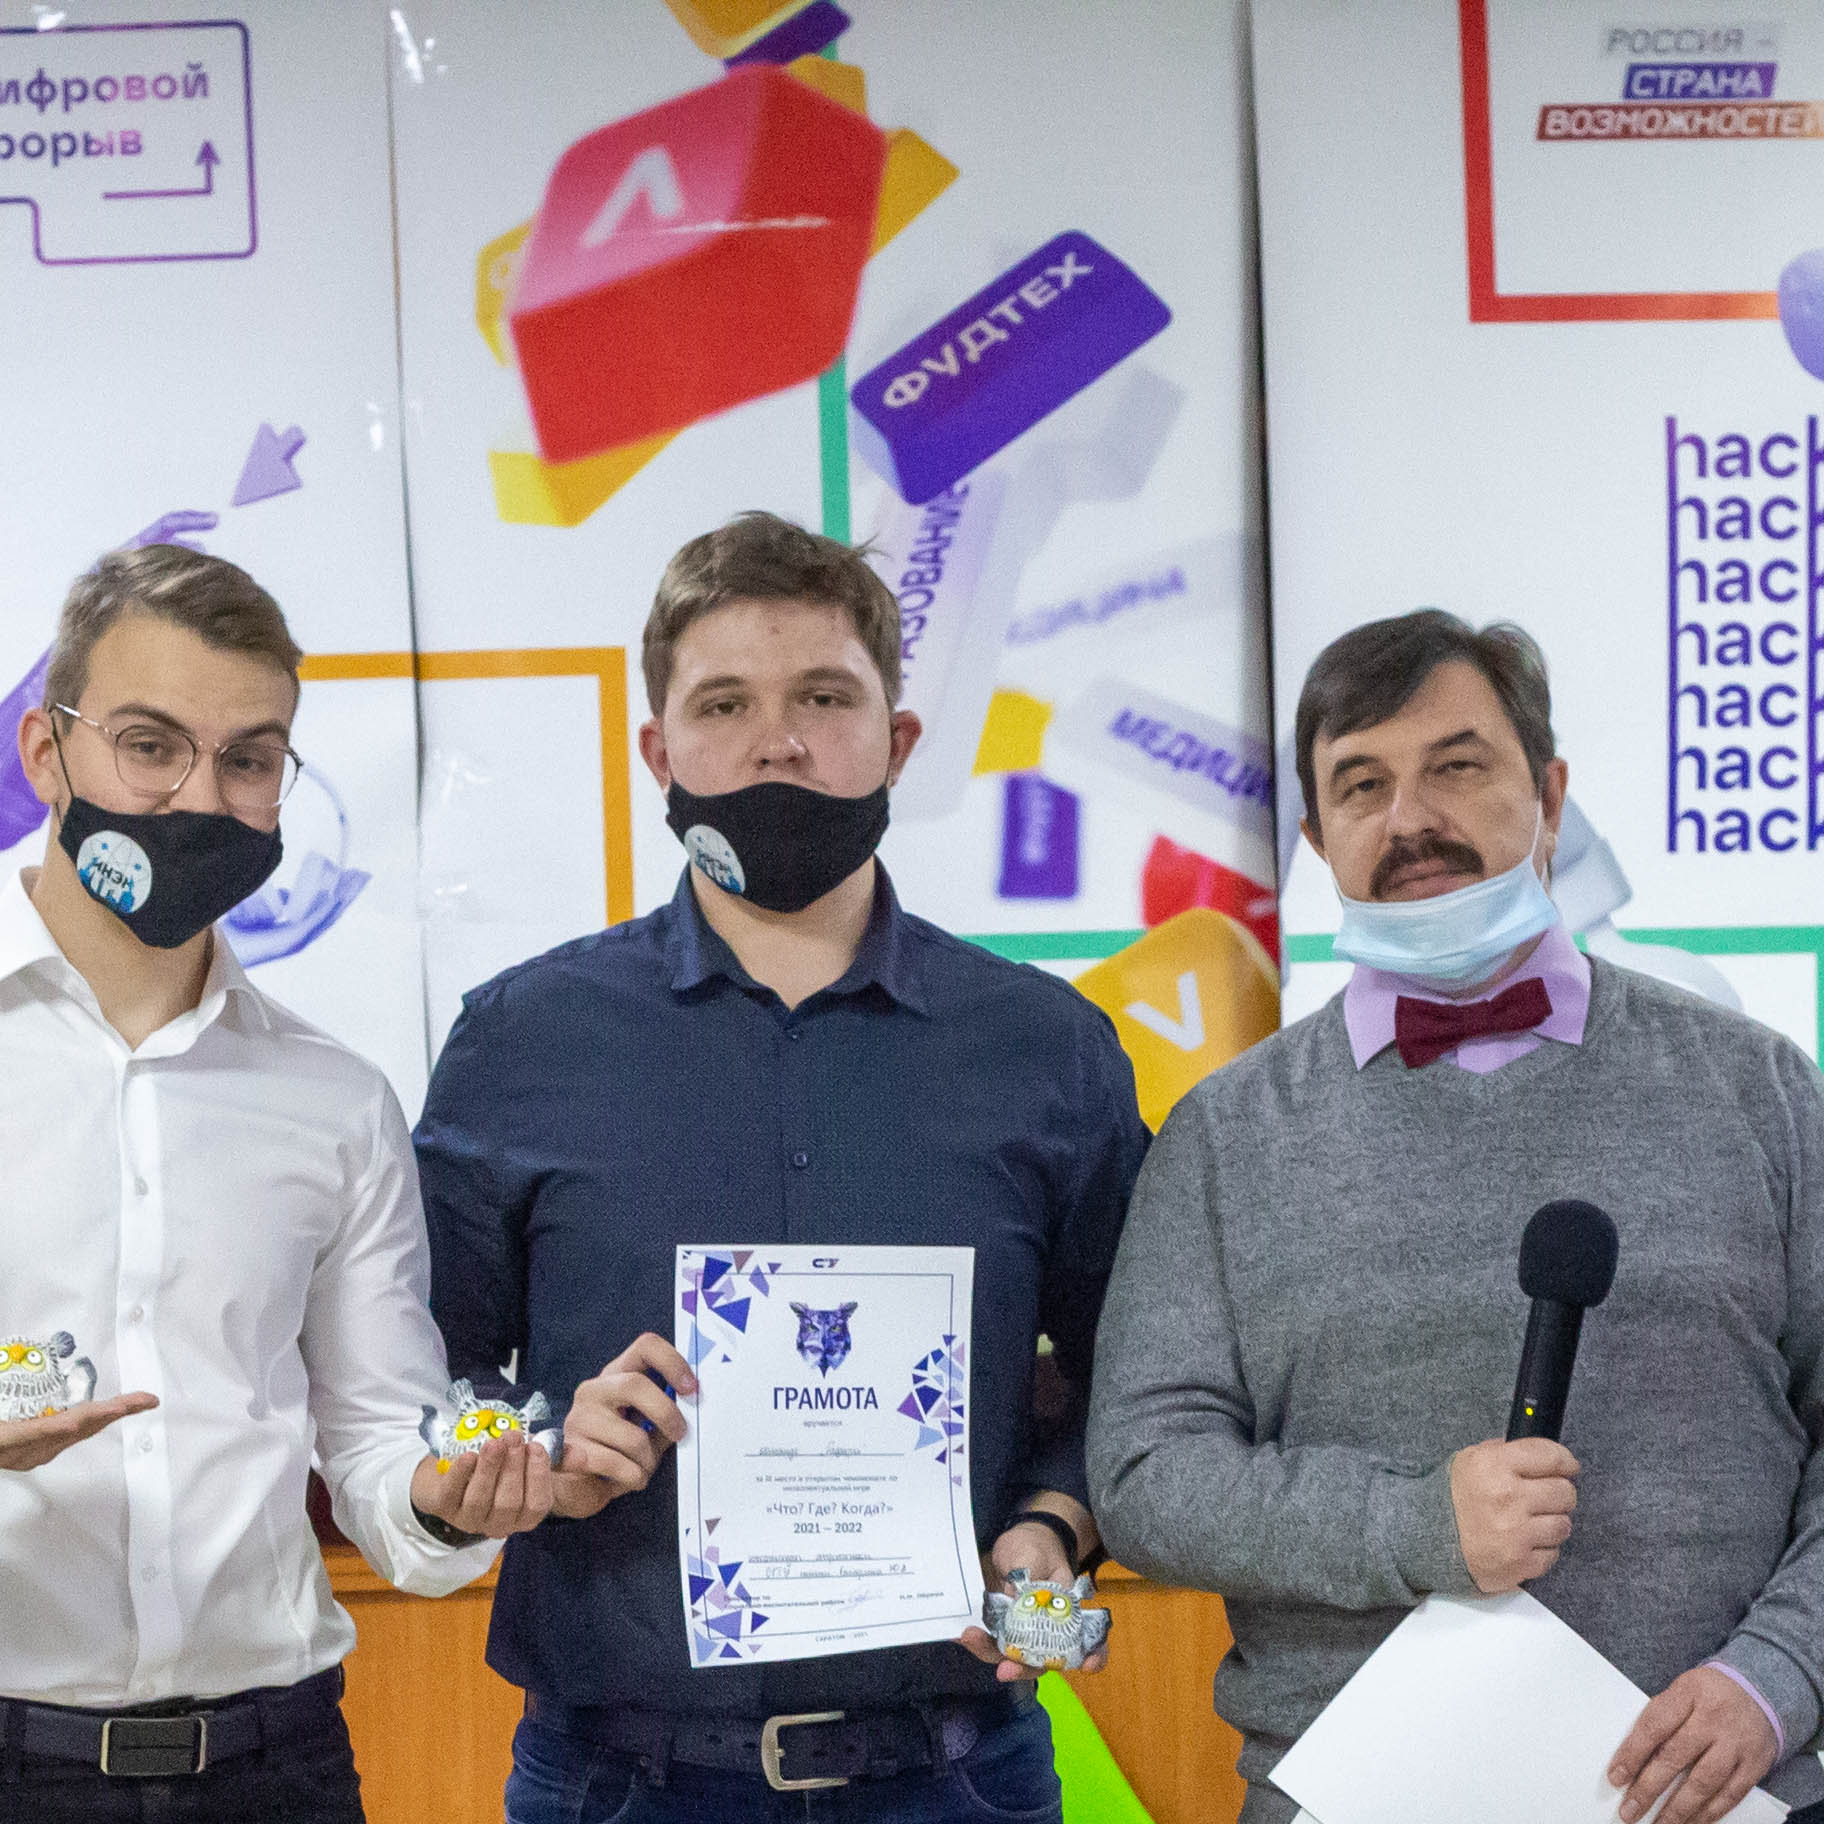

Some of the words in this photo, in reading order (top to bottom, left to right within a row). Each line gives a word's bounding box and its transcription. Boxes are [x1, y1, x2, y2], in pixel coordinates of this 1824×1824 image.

[1631, 69, 1764, 97] СТРАНА
[882, 252, 1094, 408] ФУДТЕХ
[773, 1386, 879, 1410] ГРАМОТА
[766, 1502, 804, 1515] «Что?
[808, 1502, 837, 1516] Где?
[841, 1502, 894, 1516] Когда?»
[794, 1522, 821, 1534] 2021
[835, 1522, 863, 1533] 2022
